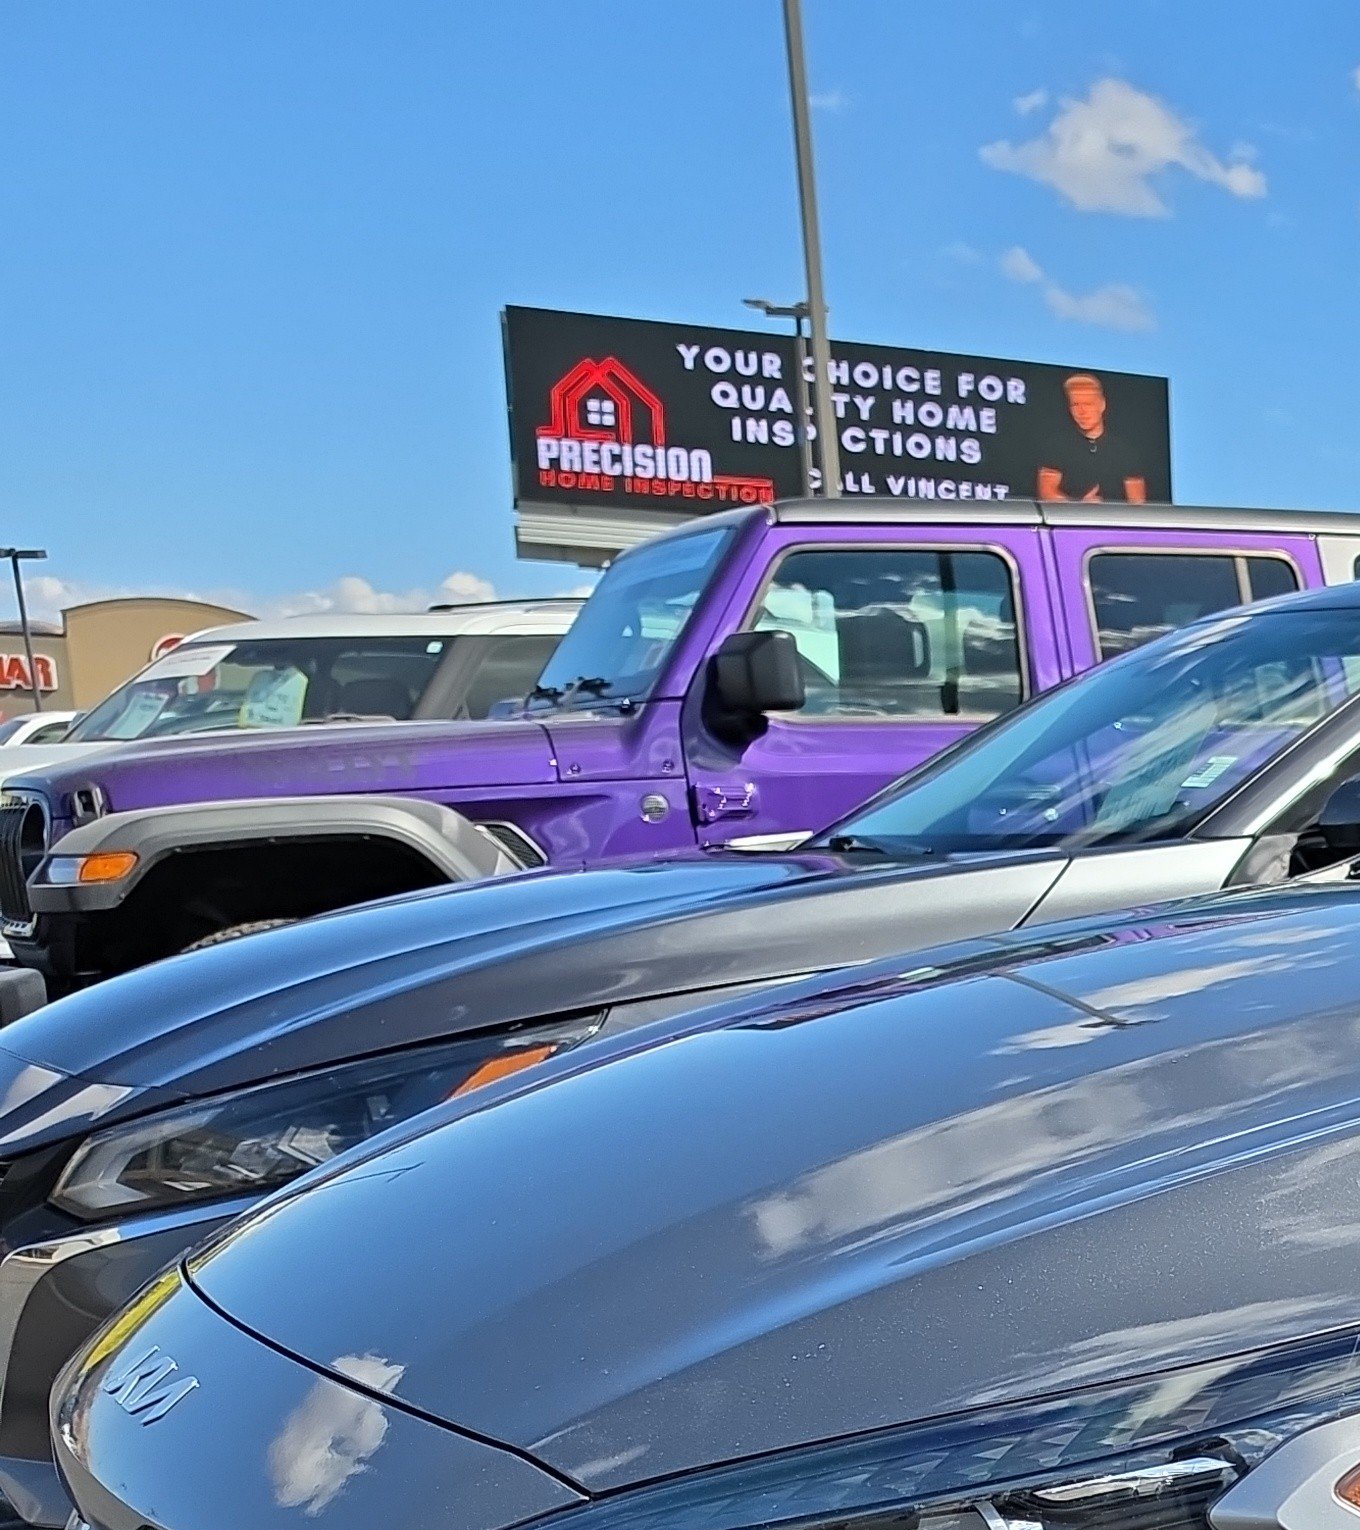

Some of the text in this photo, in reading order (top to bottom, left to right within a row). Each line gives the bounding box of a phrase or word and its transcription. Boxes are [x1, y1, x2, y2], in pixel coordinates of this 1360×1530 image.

[676, 343, 783, 380] YOUR
[957, 372, 1027, 405] FOR
[710, 380, 998, 434] QUATY HOME
[536, 436, 714, 483] PRECISION
[539, 469, 774, 505] HOME INSPECTION
[885, 472, 1010, 501] VINCENT
[103, 1344, 200, 1427] KIA
